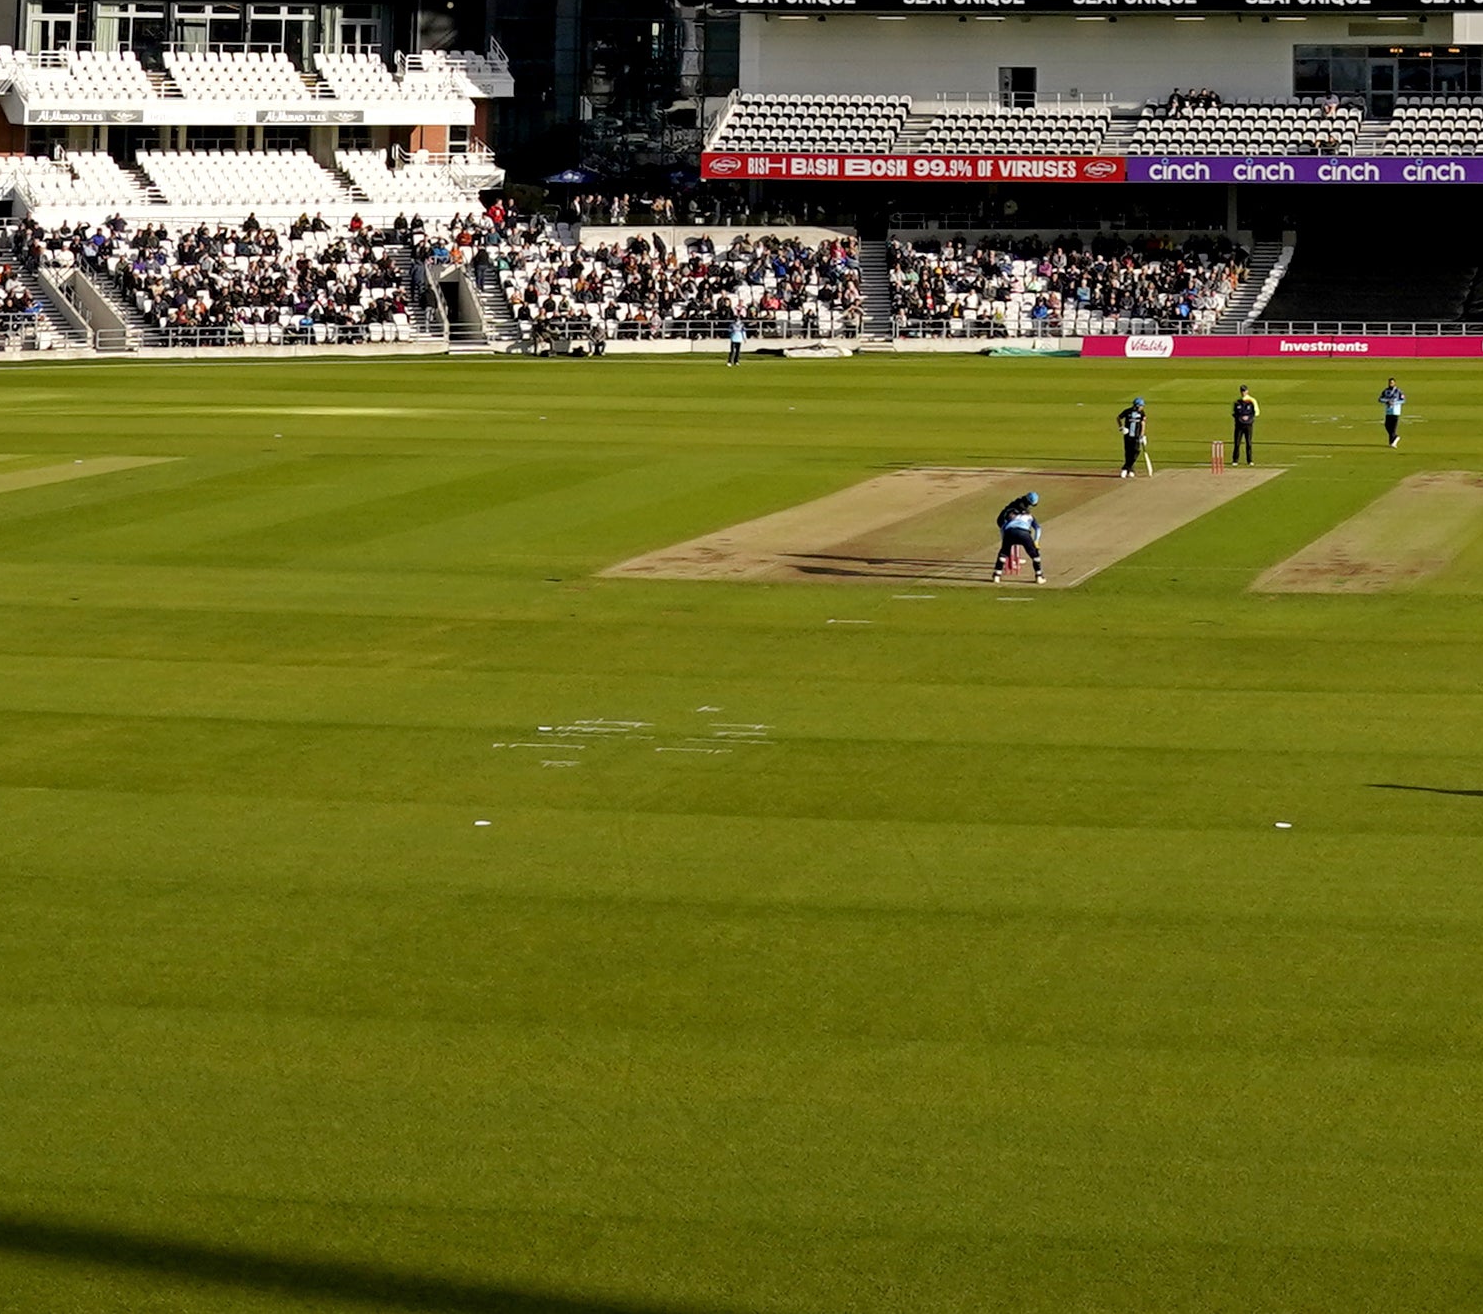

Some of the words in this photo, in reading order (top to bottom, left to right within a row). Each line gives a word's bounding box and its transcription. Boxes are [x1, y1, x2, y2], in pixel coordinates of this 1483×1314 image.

[748, 157, 787, 175] BISH
[791, 158, 838, 176] BASH
[844, 159, 908, 176] BOSH
[913, 159, 972, 177] 99.9%
[977, 160, 994, 177] OF
[998, 160, 1077, 178] VIRUSES
[1149, 158, 1210, 181] cinch
[1318, 158, 1380, 181] cinch
[1130, 339, 1168, 354] Vitality
[1280, 340, 1368, 353] Investments
